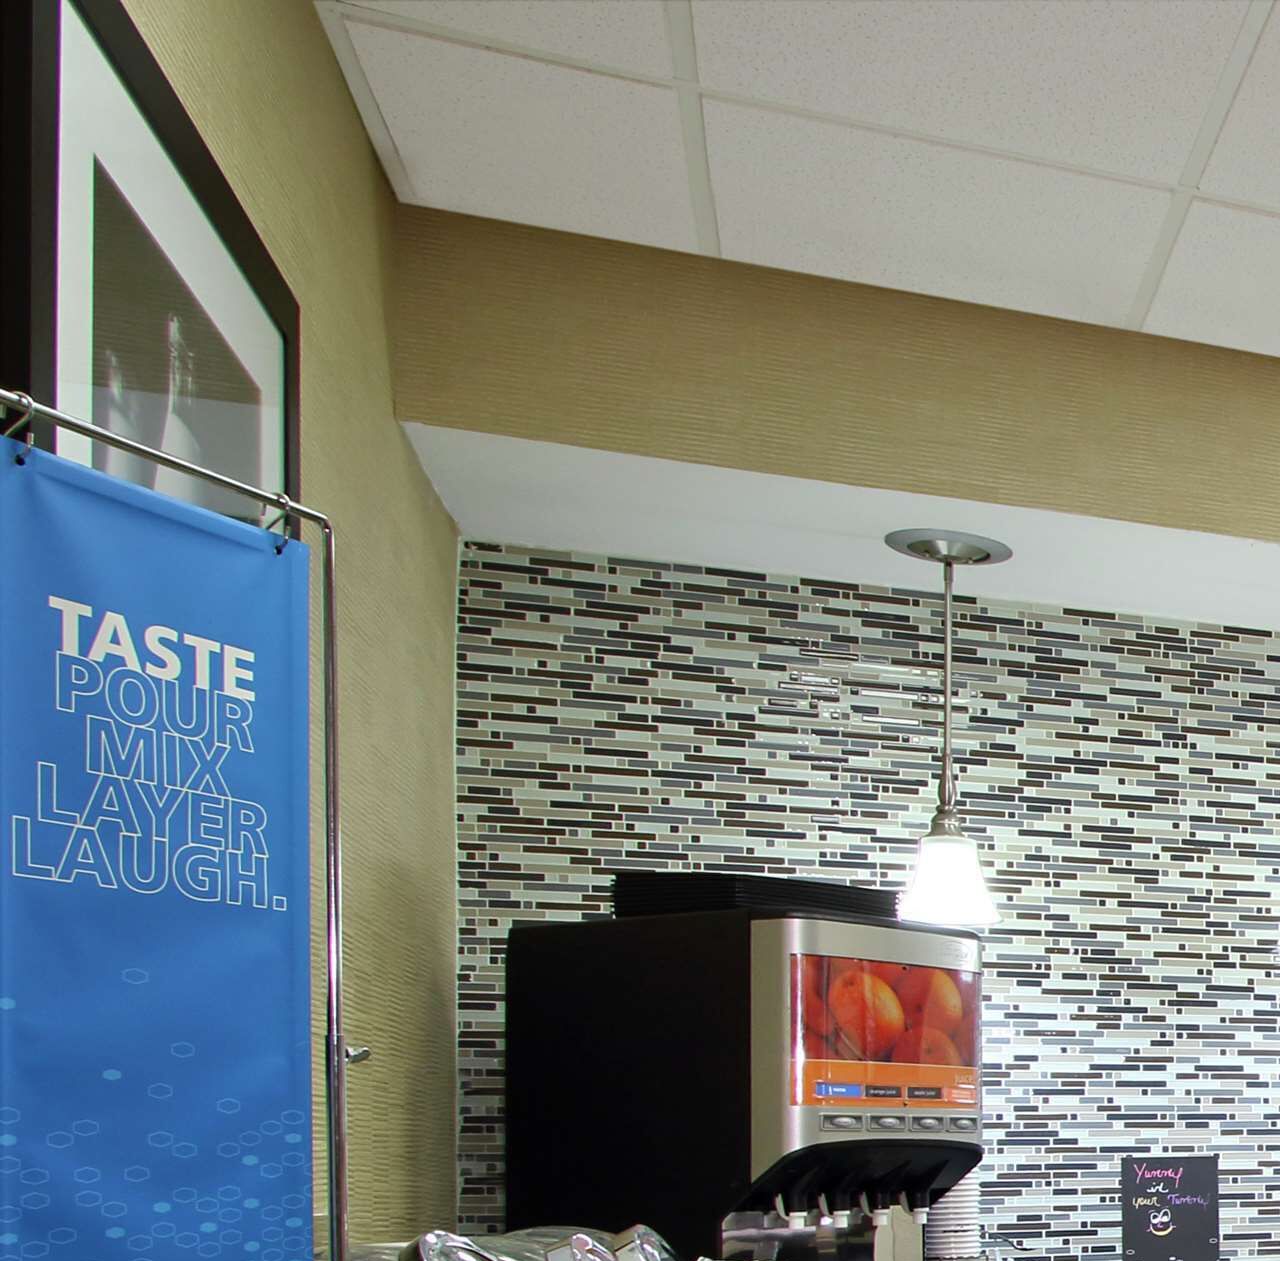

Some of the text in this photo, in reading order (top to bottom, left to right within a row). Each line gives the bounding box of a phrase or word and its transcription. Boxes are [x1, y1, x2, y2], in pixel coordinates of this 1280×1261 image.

[48, 595, 256, 702] TASTE
[56, 650, 255, 753] POUR
[86, 714, 231, 799] MIX
[37, 761, 270, 859] LAYER
[11, 815, 288, 912] LAUGH.
[1133, 1162, 1183, 1188] Yummy
